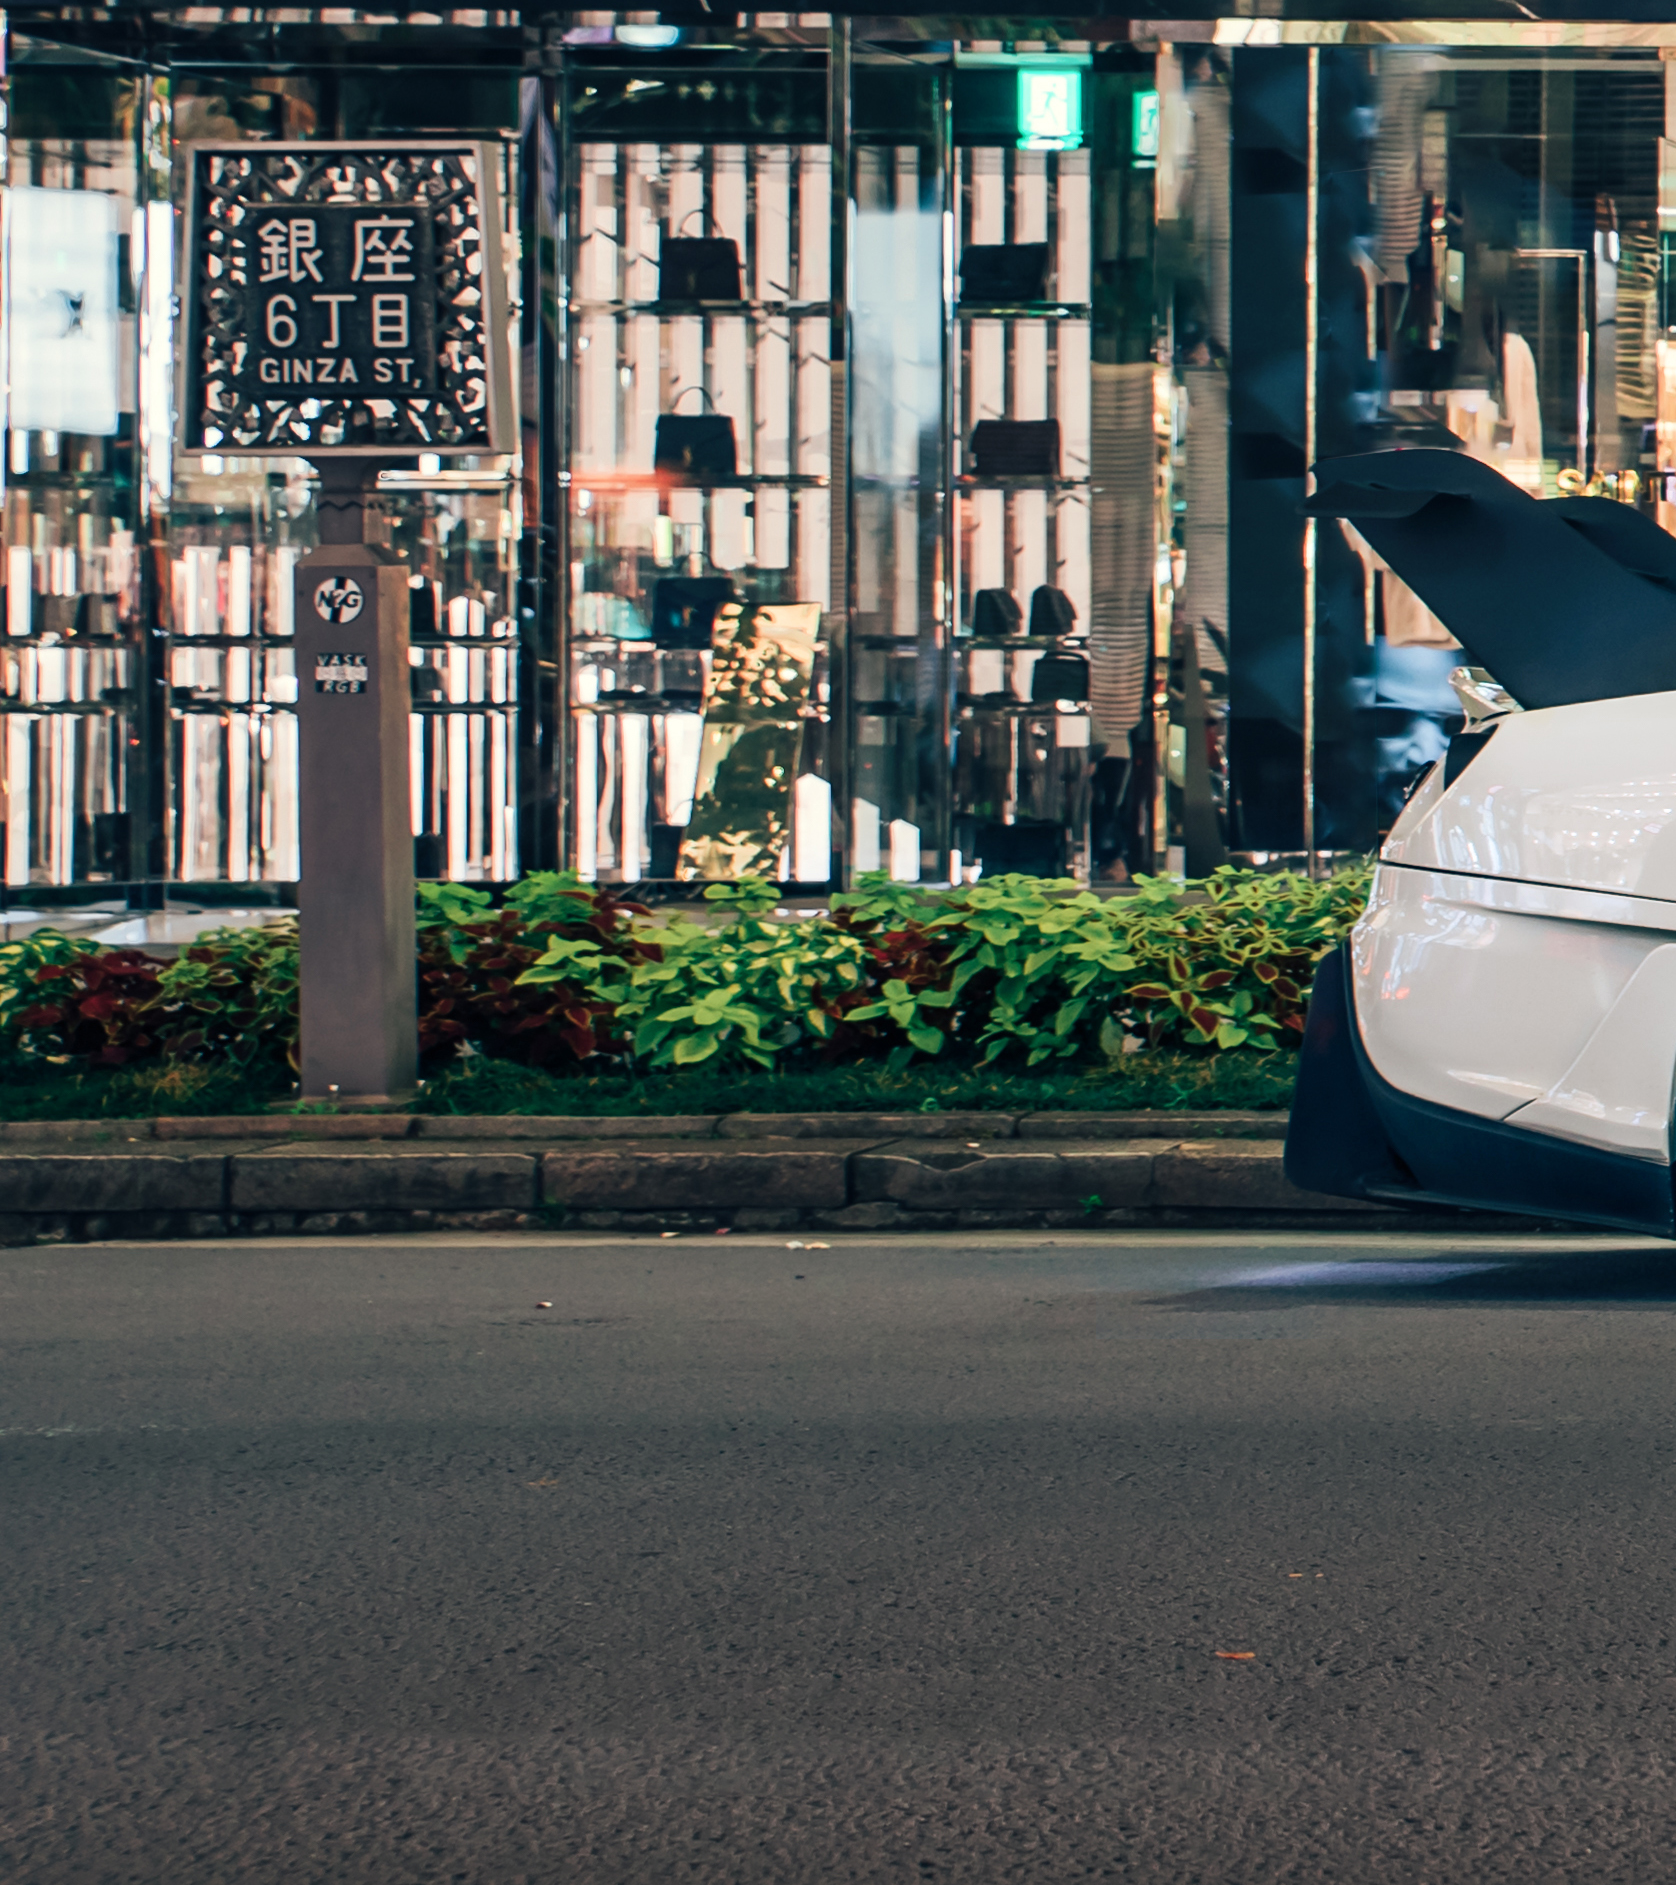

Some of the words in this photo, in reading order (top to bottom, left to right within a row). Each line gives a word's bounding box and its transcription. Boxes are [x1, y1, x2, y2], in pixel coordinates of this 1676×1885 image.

[257, 216, 417, 284] 銀座
[265, 294, 411, 349] 6丁目
[258, 357, 359, 385] GINZA
[1556, 468, 1676, 503] SAINT
[323, 681, 361, 693] RGB
